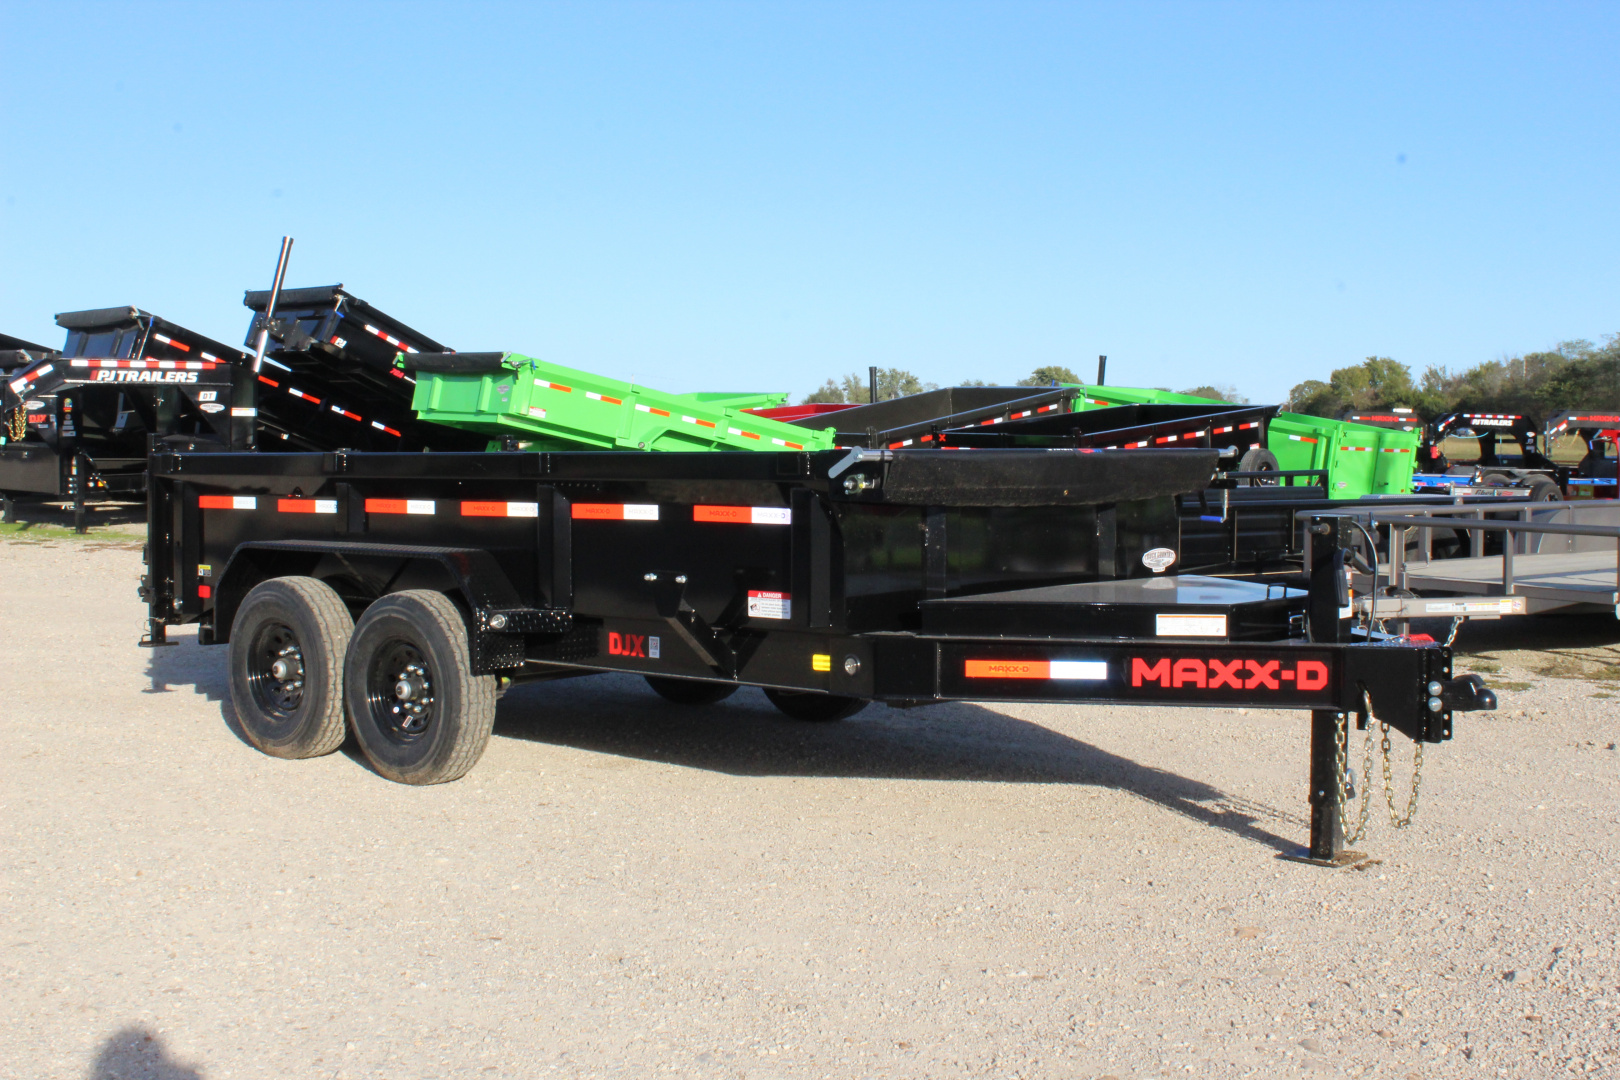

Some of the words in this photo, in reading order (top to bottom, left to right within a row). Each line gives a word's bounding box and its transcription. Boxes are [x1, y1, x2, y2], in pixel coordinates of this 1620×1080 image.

[608, 631, 646, 658] DJX
[988, 665, 1030, 673] MAXX-D
[1131, 657, 1328, 691] MAXX-D
